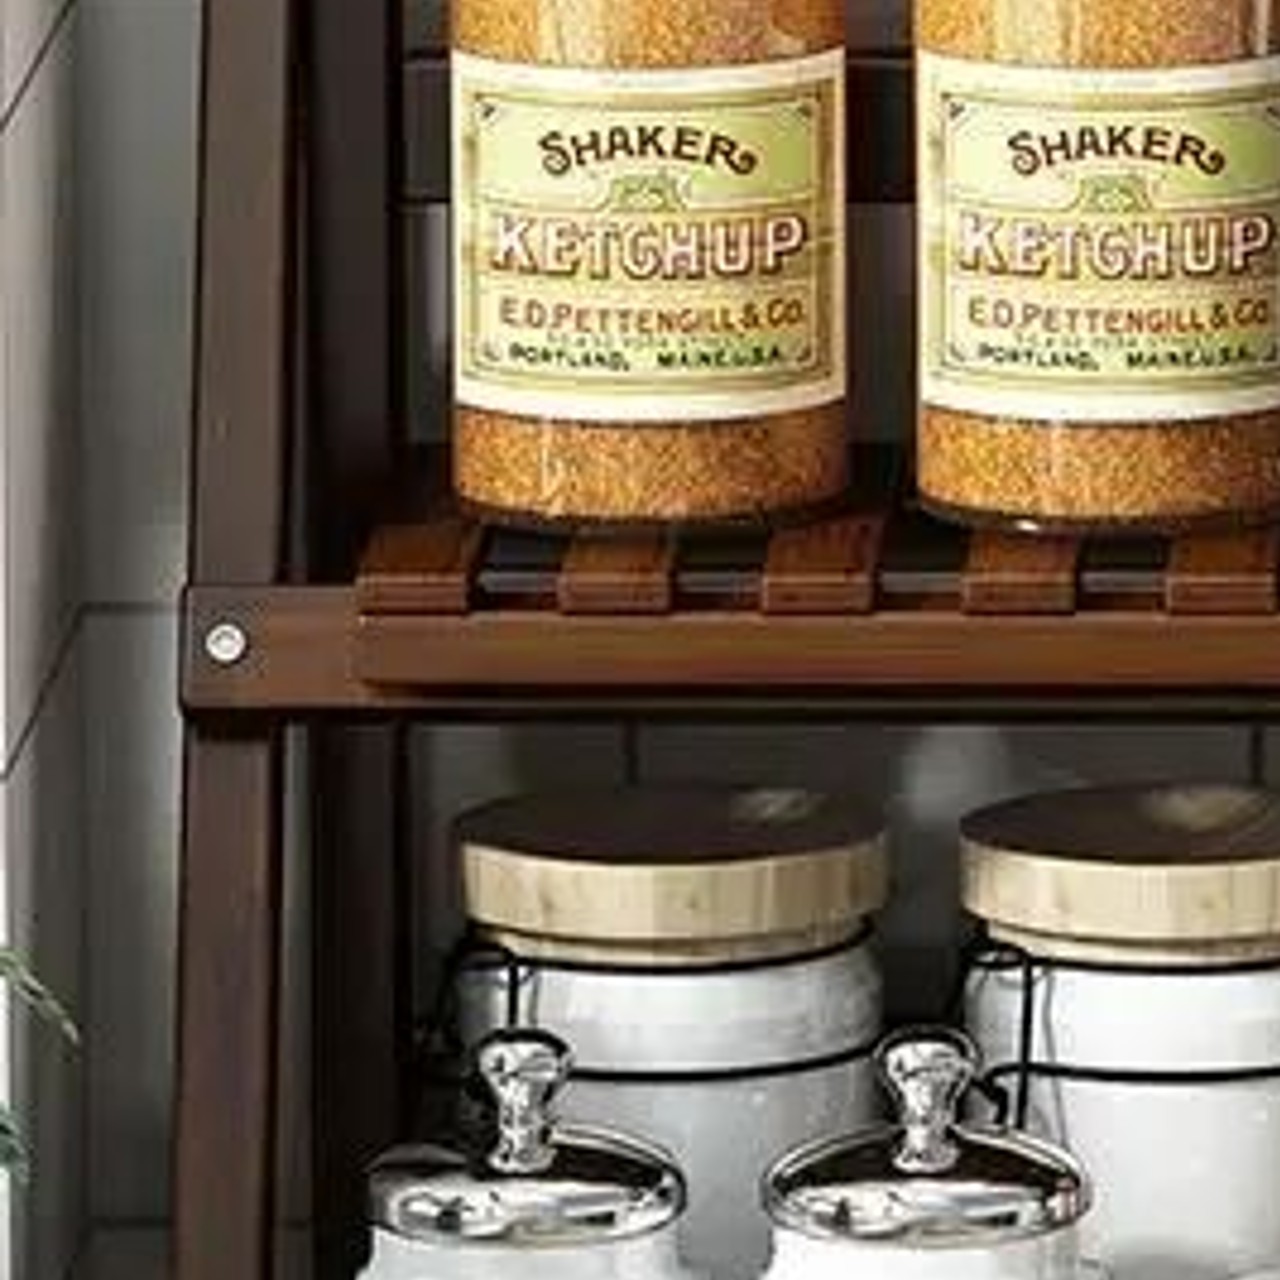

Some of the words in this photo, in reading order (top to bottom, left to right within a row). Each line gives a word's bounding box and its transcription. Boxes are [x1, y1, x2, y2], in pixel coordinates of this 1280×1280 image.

[539, 125, 758, 176] SHAKER
[1007, 125, 1226, 176] SHAKER
[490, 213, 808, 282] KETCHUP
[958, 213, 1276, 282] KETCHUP
[738, 302, 761, 331] &
[1210, 302, 1230, 330] &
